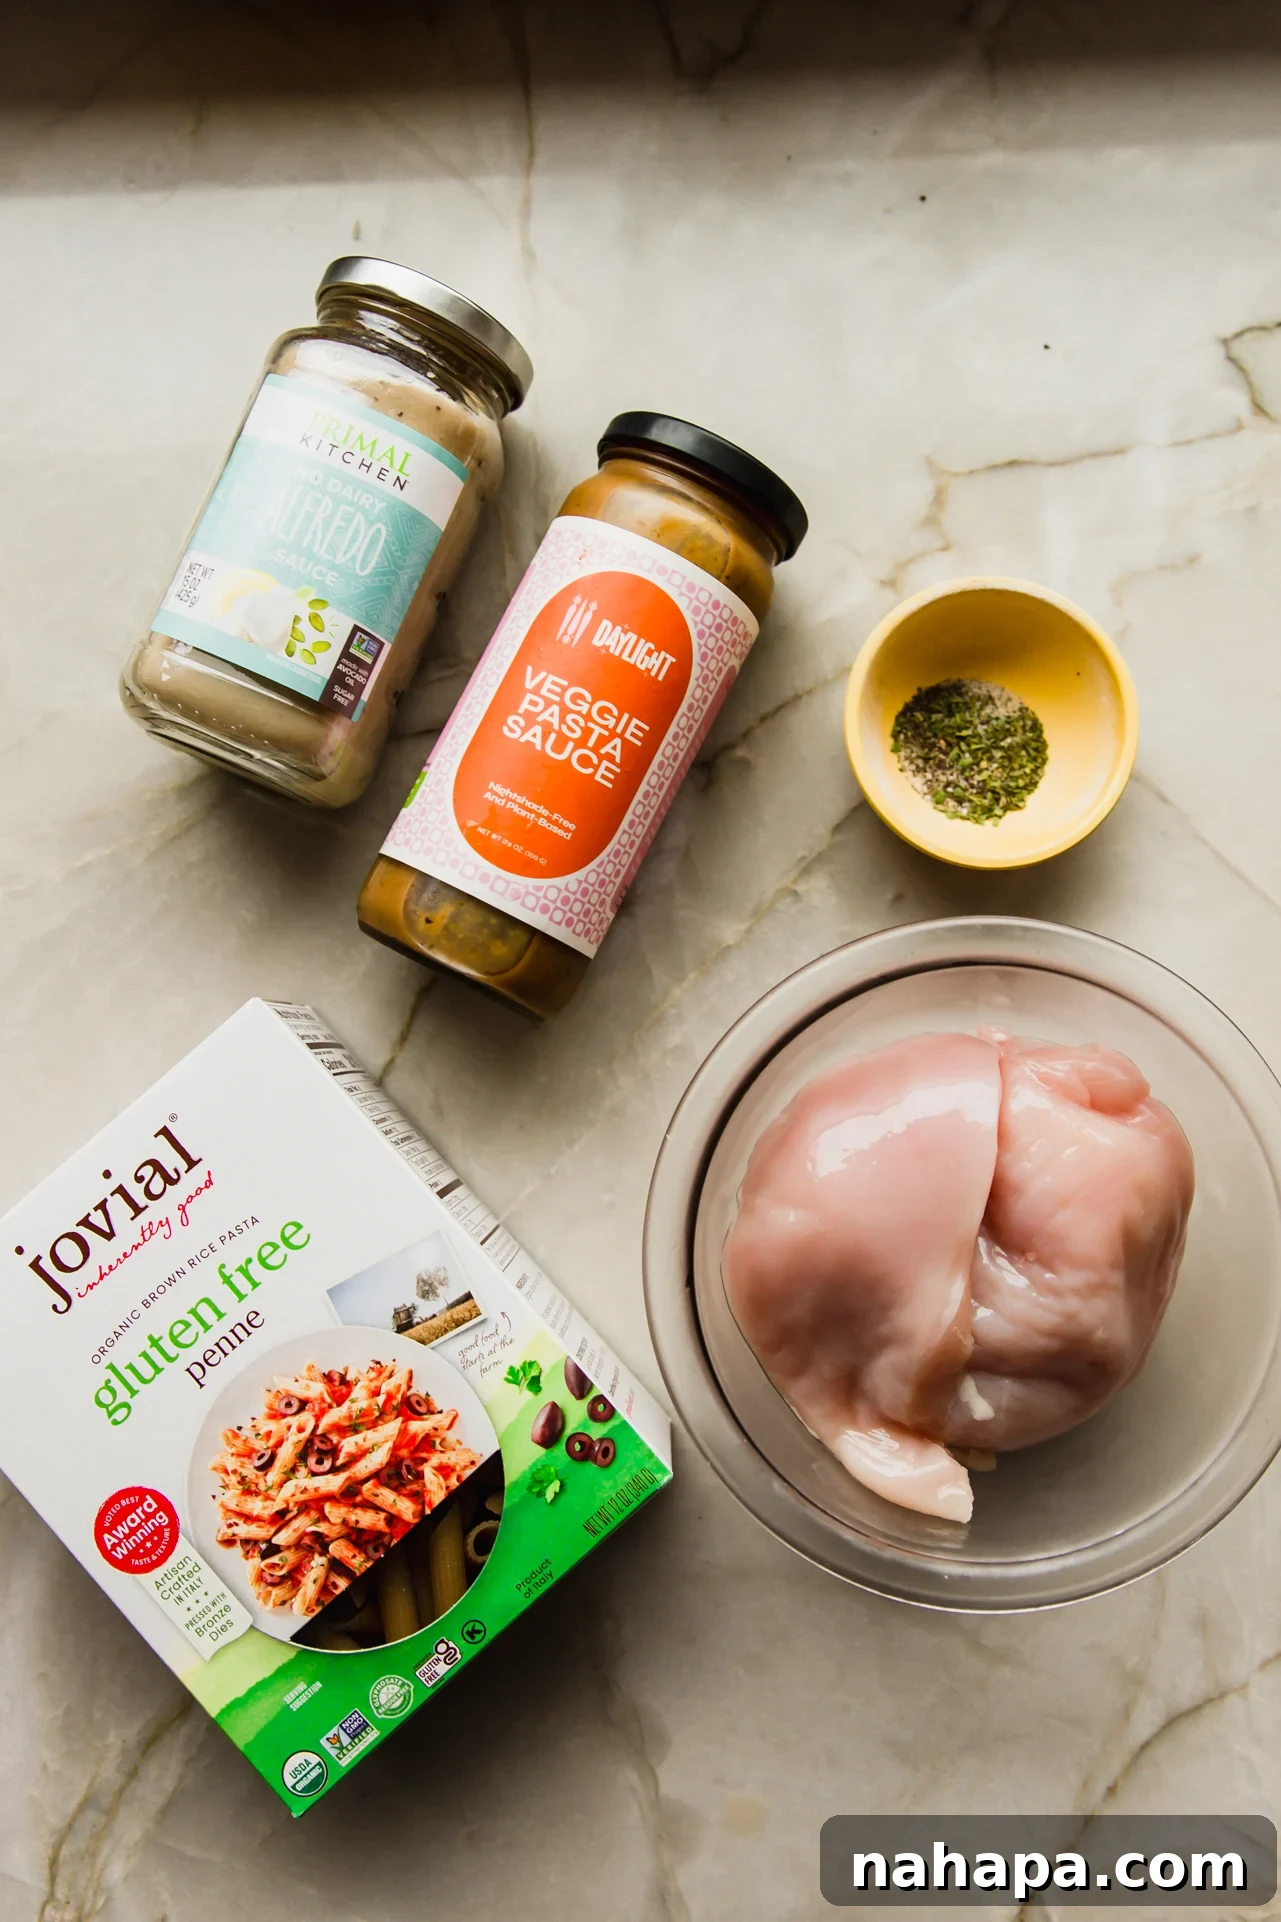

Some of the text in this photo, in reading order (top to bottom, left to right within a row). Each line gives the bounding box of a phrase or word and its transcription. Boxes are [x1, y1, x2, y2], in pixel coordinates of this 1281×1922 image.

[307, 411, 413, 477] PRIMAL
[300, 433, 408, 491] KITCHEN
[328, 478, 387, 514] DAIRY
[262, 482, 387, 576] ALFREDO
[187, 562, 215, 580] NET WT
[189, 577, 201, 591] OZ
[274, 547, 340, 587] SAUCE
[592, 619, 677, 681] DAYLIGHT
[336, 664, 367, 684] AVOCADO
[333, 685, 355, 702] SUGAR
[333, 693, 350, 707] FREE
[524, 665, 650, 747] VEGGIE
[518, 693, 622, 763] PASTA
[502, 714, 621, 789] SAUCE
[483, 791, 573, 840] And Plant-Based
[488, 781, 577, 831] Nightshade-Free
[477, 826, 491, 837] NET
[491, 832, 502, 842] WT
[75, 1169, 214, 1298] inherently good
[91, 1215, 260, 1365] ORGANIC BROWN RICE PASTA
[93, 1220, 311, 1427] gluten free
[184, 1309, 265, 1389] penne
[458, 1323, 500, 1364] good food
[488, 1343, 498, 1357] at
[480, 1359, 504, 1379] farm
[103, 1495, 140, 1527] VOTED BEST
[582, 1466, 659, 1538] NET WT 12 OZ (340 G)
[103, 1494, 158, 1550] Award
[111, 1511, 169, 1560] Winning
[131, 1527, 171, 1566] TASTE & TEXTURE
[154, 1555, 193, 1591] Artisan
[160, 1561, 202, 1601] Crafted
[515, 1558, 553, 1593] Product
[523, 1569, 554, 1599] of Italy
[173, 1576, 204, 1606] IN ITALY
[184, 1592, 227, 1631] PRESSED WITH
[194, 1604, 232, 1638] Bronze
[208, 1619, 234, 1642] Dies
[418, 1655, 442, 1678] GLUTEN
[424, 1669, 440, 1686] FREE
[283, 1681, 308, 1705] SERVING
[289, 1680, 323, 1712] SUGGESTION
[373, 1677, 403, 1707] GLYPHOSATE
[341, 1712, 359, 1729] NON
[346, 1717, 363, 1734] GMO
[337, 1727, 373, 1758] VERIFIED
[288, 1758, 313, 1780] USDA
[295, 1765, 323, 1791] ORGANIC
